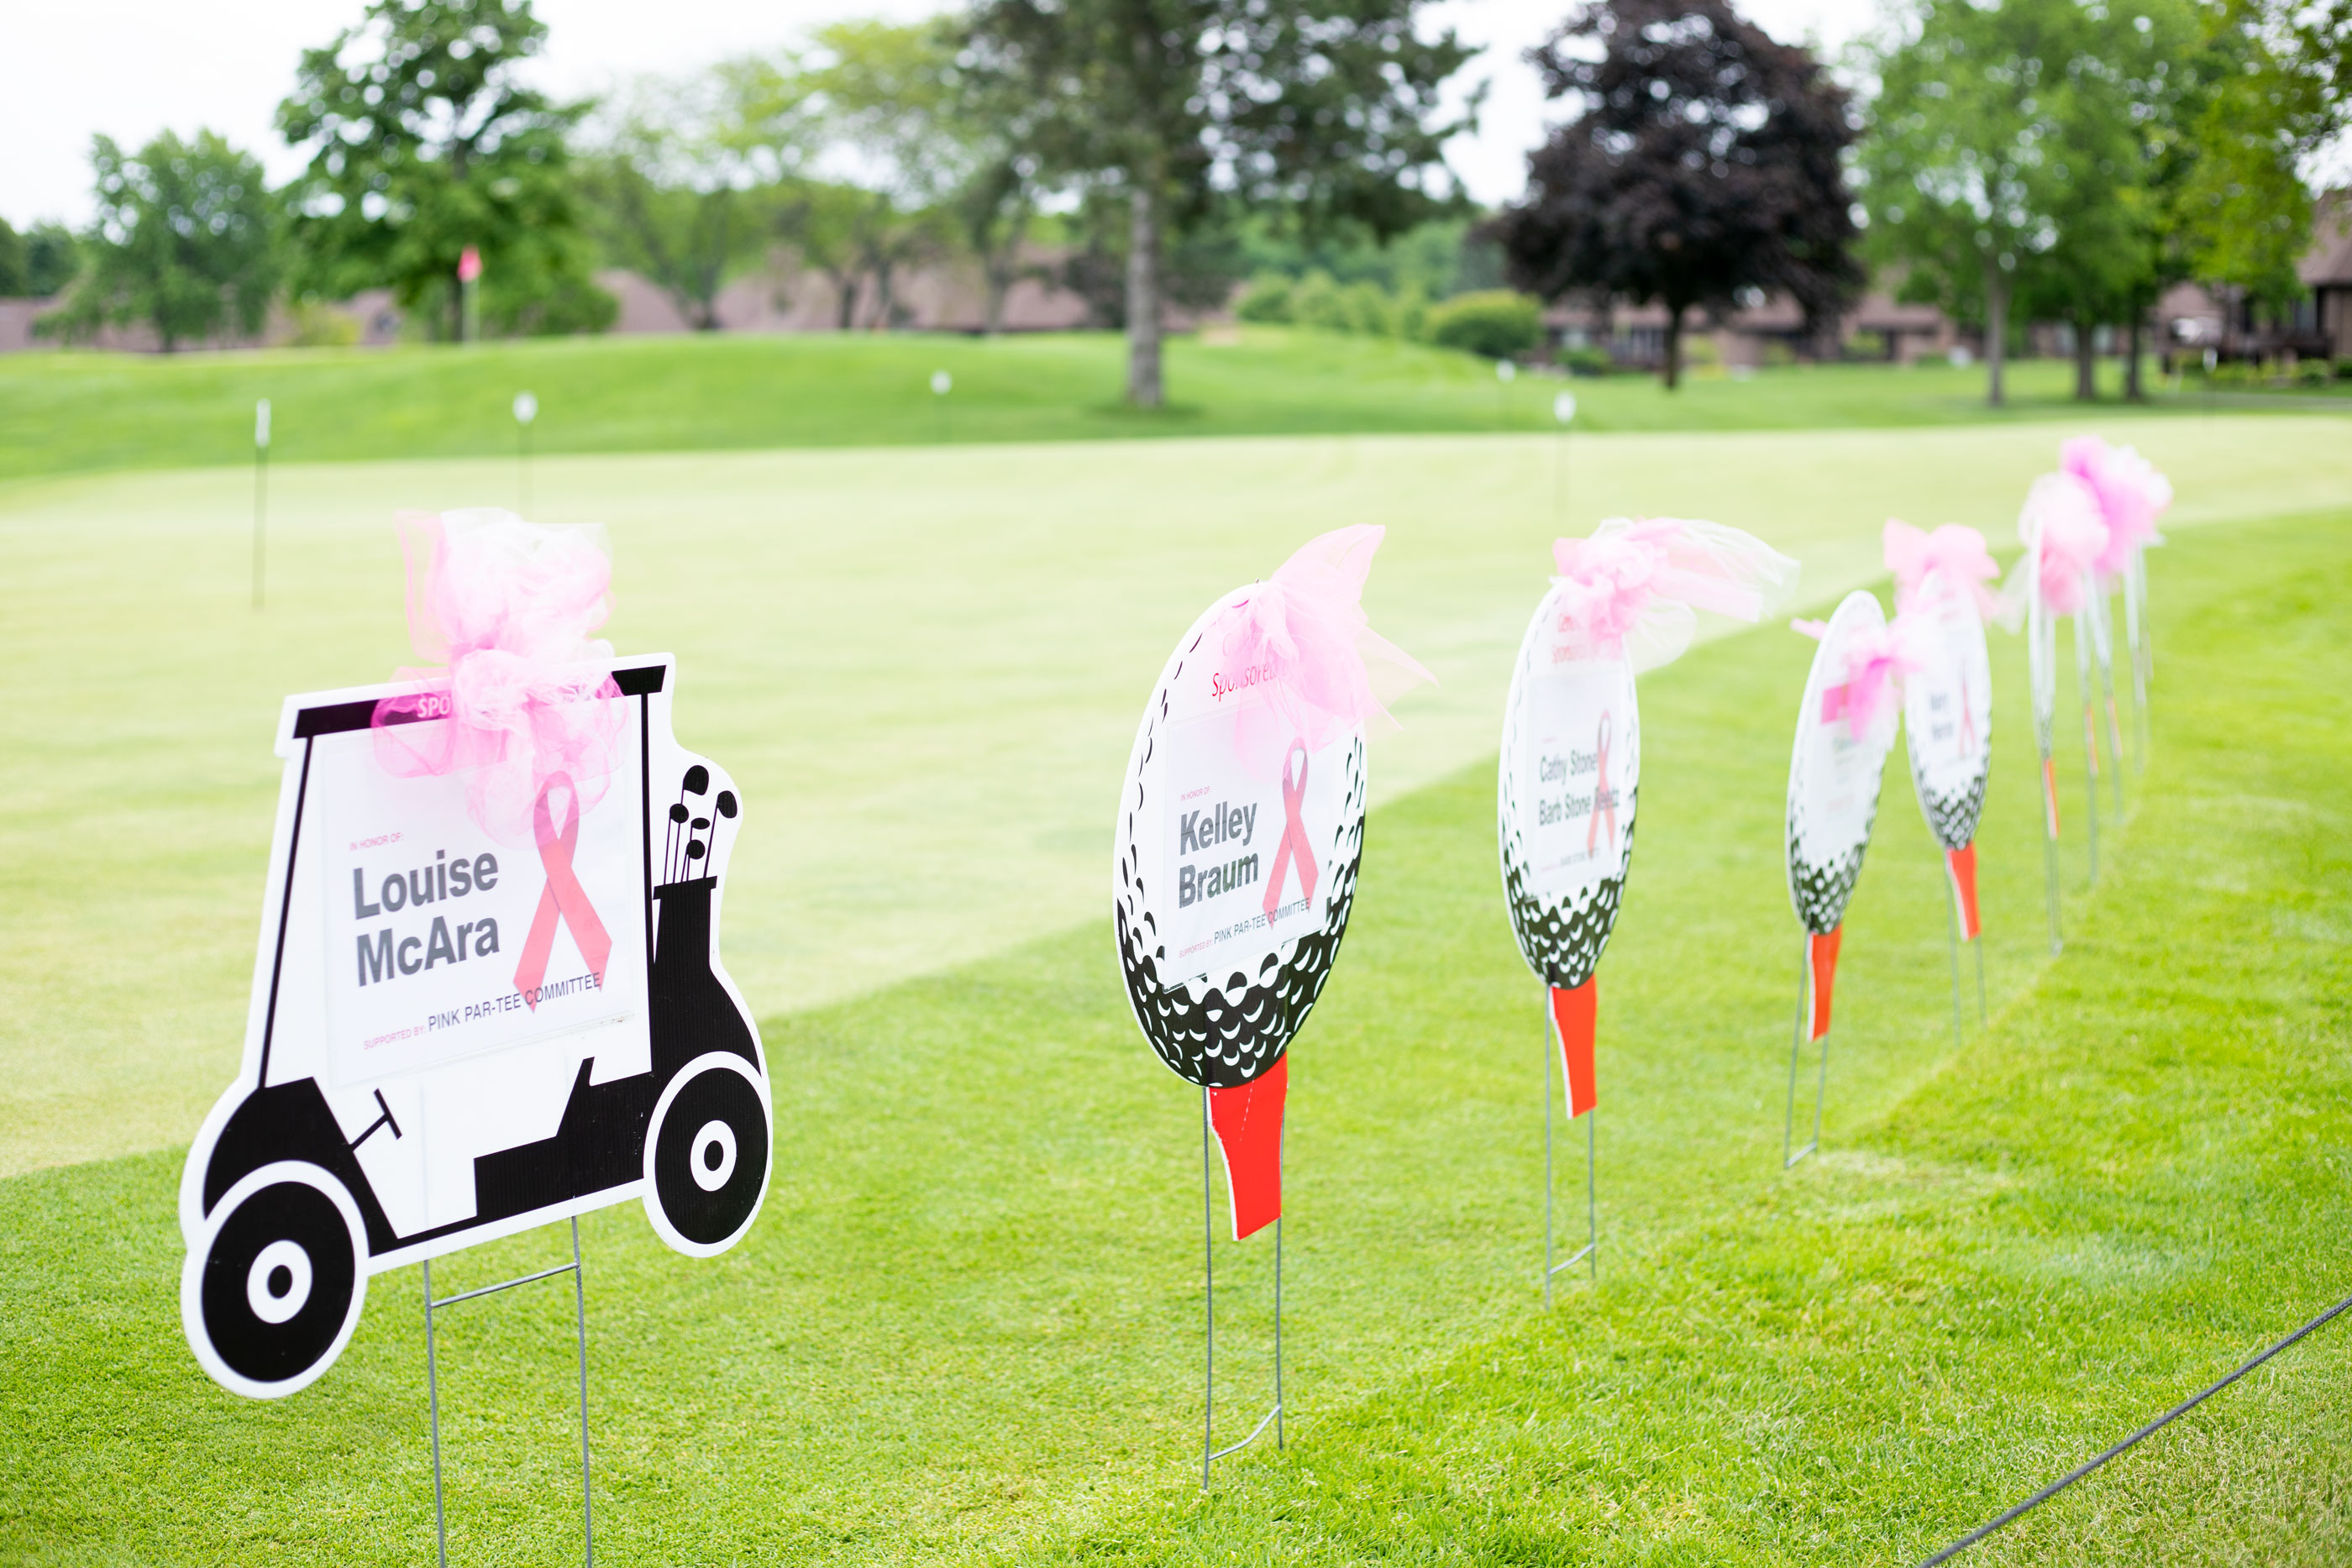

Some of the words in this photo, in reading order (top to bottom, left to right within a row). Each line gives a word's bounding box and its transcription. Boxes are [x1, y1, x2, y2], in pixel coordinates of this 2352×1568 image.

[1570, 749, 1598, 776] Stone
[1186, 788, 1204, 800] HONOR
[1539, 795, 1562, 826] Barb
[1565, 792, 1591, 820] Stone
[349, 842, 357, 851] IN
[360, 835, 388, 849] HONOR
[1179, 800, 1257, 856] Kelley
[353, 848, 499, 920] Louise
[1179, 852, 1258, 909] Braum
[356, 915, 500, 988] McAra
[1179, 941, 1205, 958] SUPPORTED
[1214, 926, 1232, 945] PINK
[1234, 914, 1267, 936] PAR-TEE
[1268, 897, 1310, 925] COMMITTEE
[364, 1028, 412, 1050] SUPPORTED
[428, 1009, 460, 1031] PINK
[465, 993, 522, 1022] PAR-TEE
[525, 971, 601, 1005] COMMITTEE
